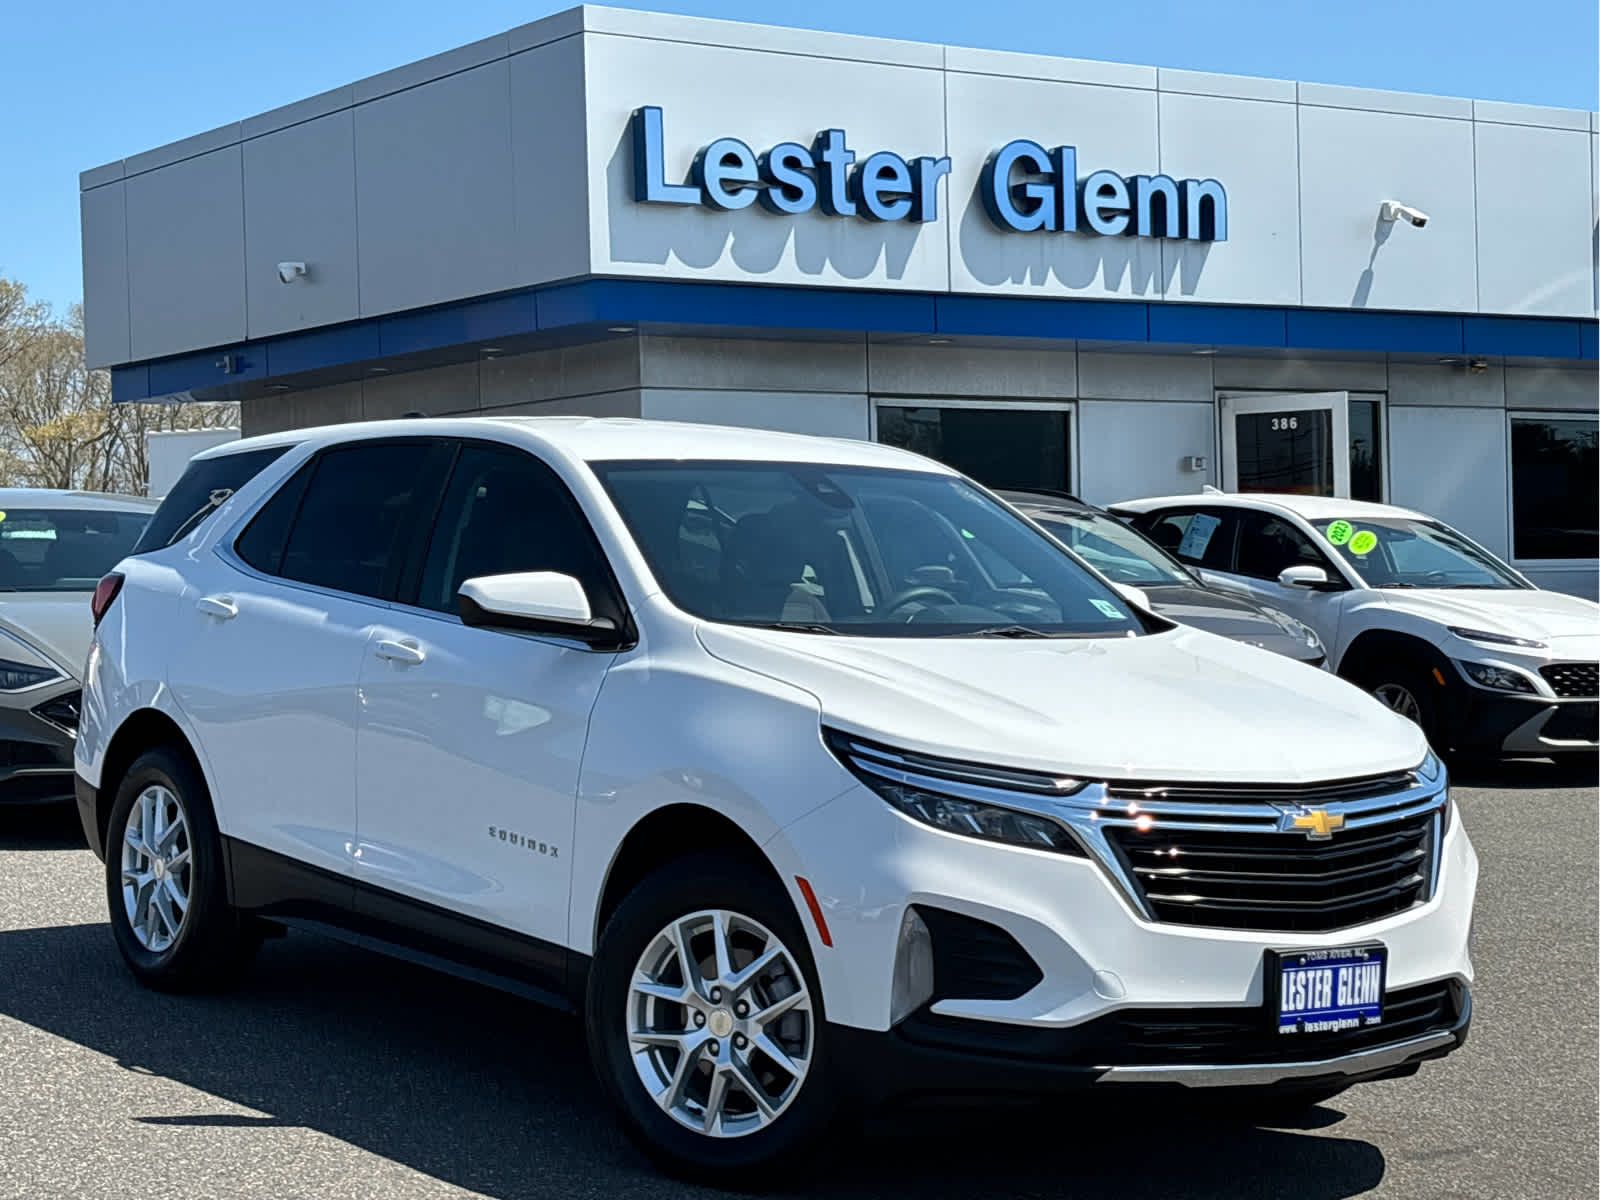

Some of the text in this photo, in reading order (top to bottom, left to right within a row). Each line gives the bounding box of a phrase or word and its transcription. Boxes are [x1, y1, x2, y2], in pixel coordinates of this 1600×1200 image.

[632, 105, 1228, 242] Lester Glenn
[1271, 416, 1298, 431] 386
[487, 825, 559, 858] EQUINOX
[1281, 964, 1381, 1011] LESTER GLENN
[1304, 1018, 1359, 1032] lesterglenn
